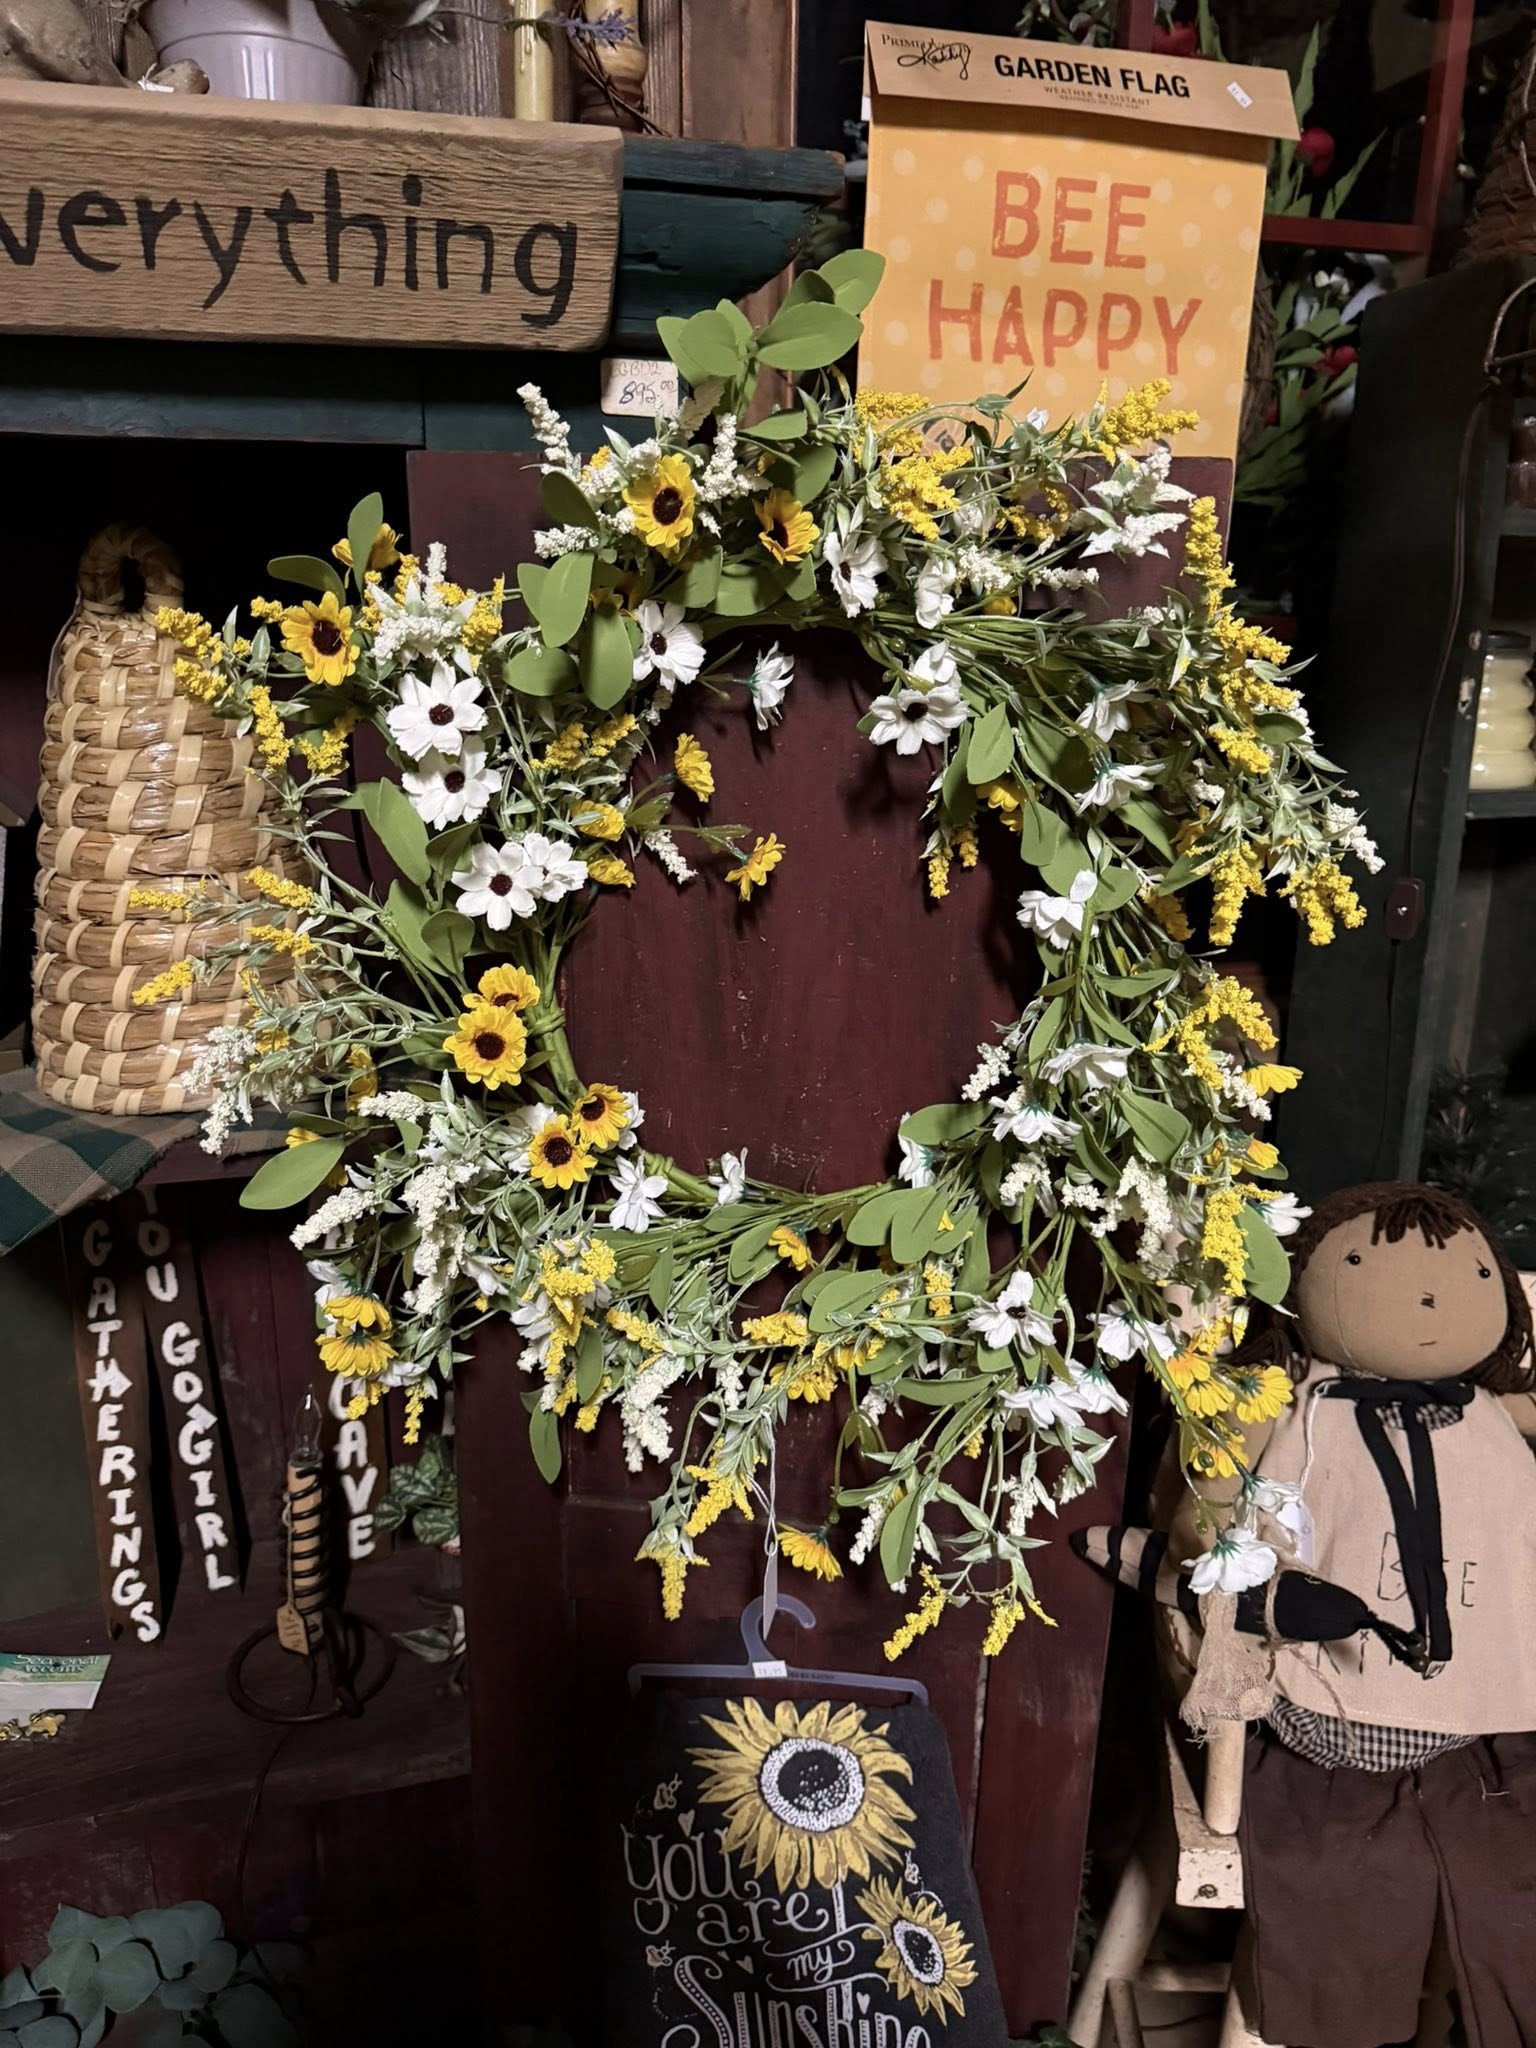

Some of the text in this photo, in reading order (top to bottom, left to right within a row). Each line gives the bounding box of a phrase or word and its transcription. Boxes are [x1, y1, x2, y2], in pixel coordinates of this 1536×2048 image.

[994, 54, 1191, 98] GARDEN FLAG
[991, 170, 1151, 270] BEE
[928, 279, 1203, 376] HAPPY
[161, 1321, 204, 1403] GO
[83, 1219, 160, 1642] GATHERINGS
[178, 1419, 235, 1591] GIRL
[620, 1823, 761, 1935] you
[697, 1891, 829, 1947] are
[786, 1939, 855, 1983] my
